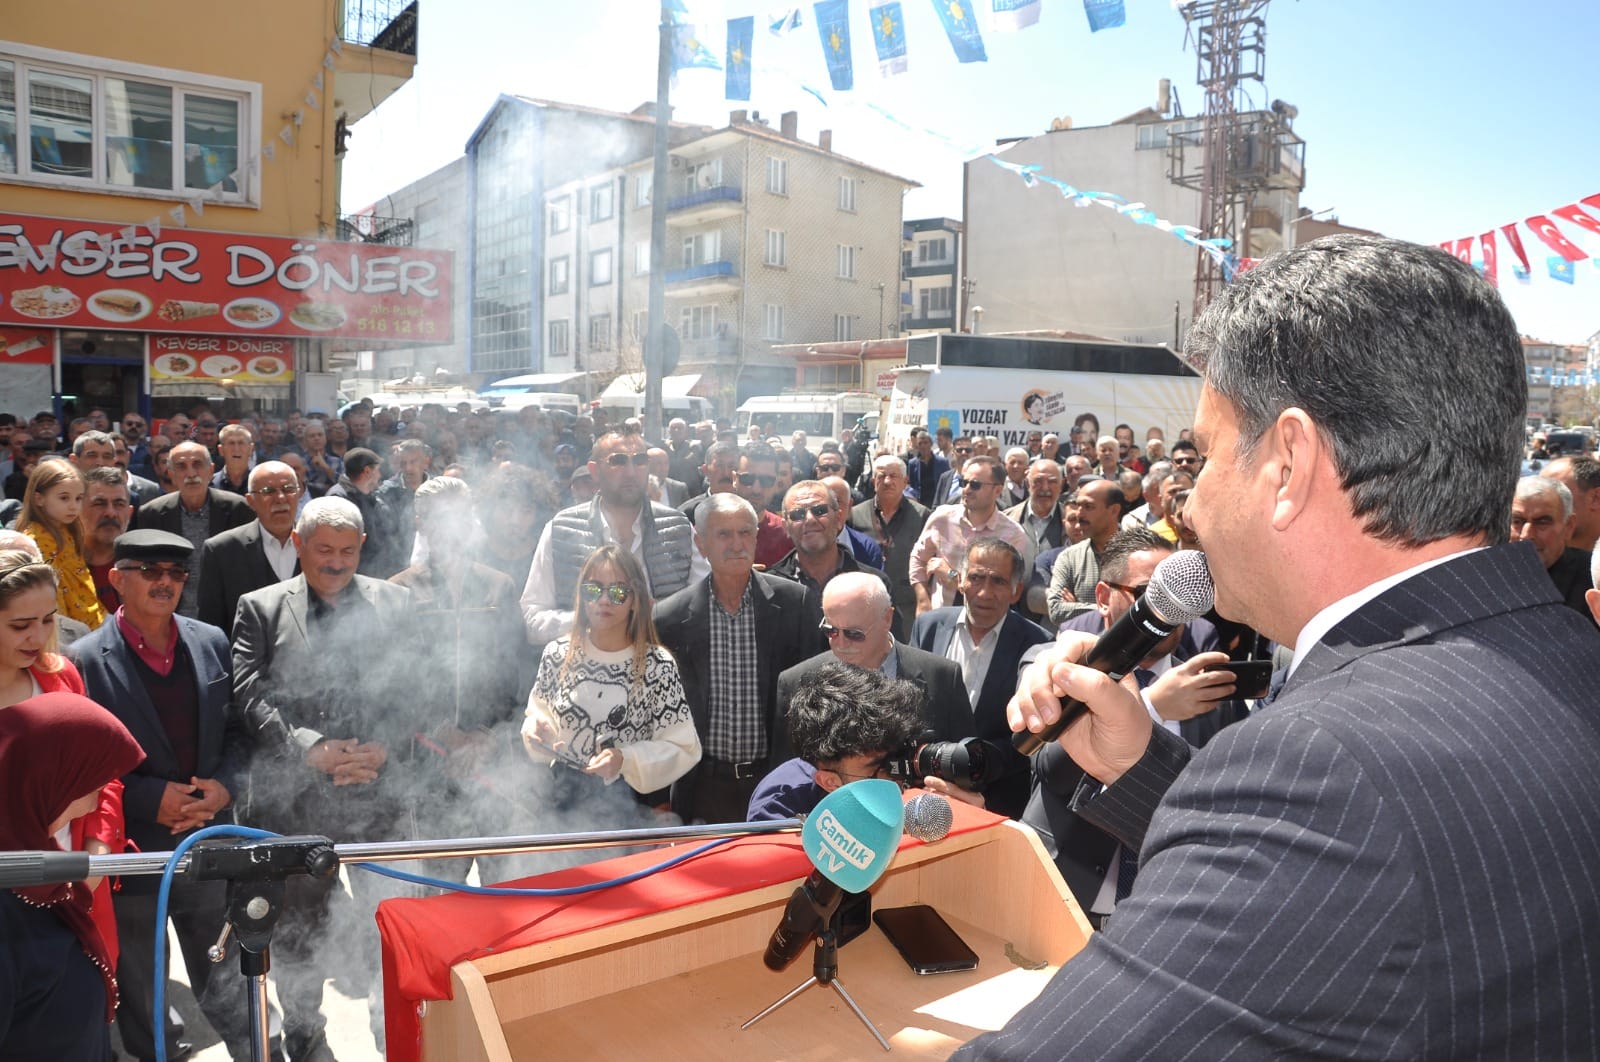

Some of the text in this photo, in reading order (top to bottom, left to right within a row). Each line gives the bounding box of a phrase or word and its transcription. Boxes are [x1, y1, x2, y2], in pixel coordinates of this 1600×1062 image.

[225, 243, 439, 297] DÖNER
[392, 319, 411, 334] 12
[156, 336, 284, 353] KEVSER DÖNER
[962, 408, 1008, 425] YOZGAT
[820, 815, 869, 865] Çamlık
[815, 841, 847, 873] TV
